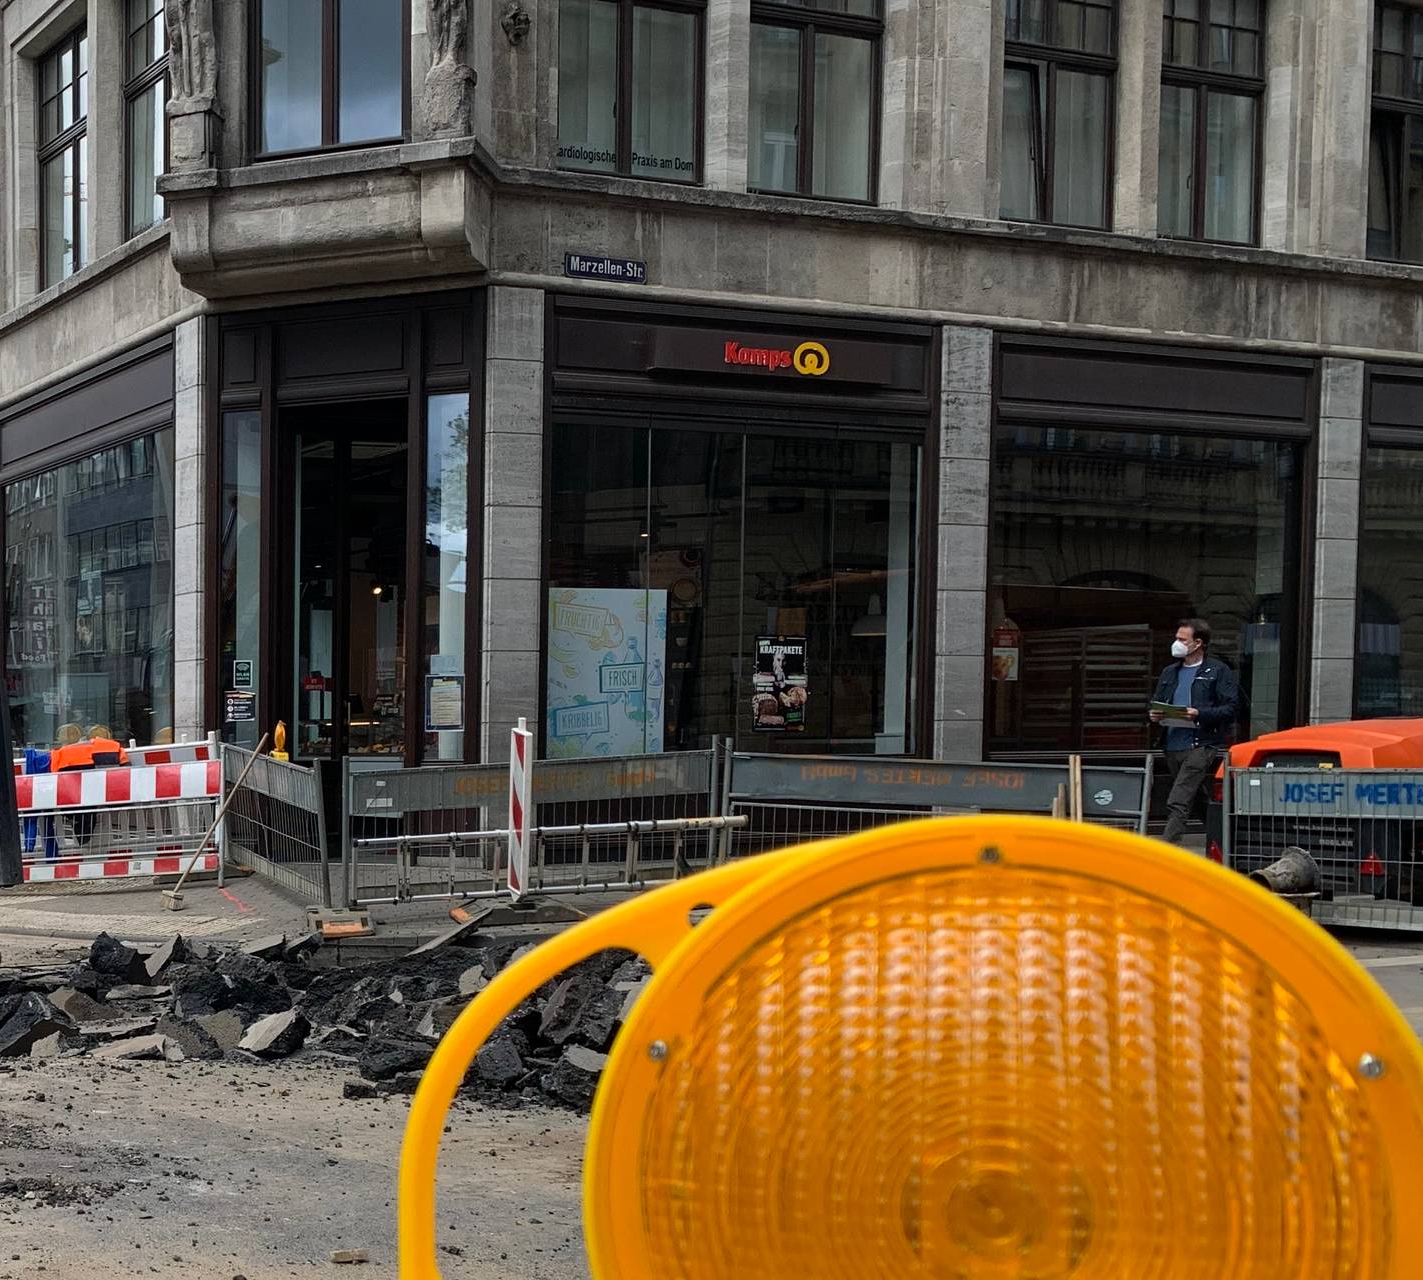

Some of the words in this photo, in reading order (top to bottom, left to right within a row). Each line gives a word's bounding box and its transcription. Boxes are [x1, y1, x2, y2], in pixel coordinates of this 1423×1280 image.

[632, 152, 657, 168] Praxis
[660, 157, 673, 169] am
[675, 157, 694, 171] Dom
[570, 255, 644, 279] Marzellen-Str.
[724, 341, 793, 371] Kamps
[759, 645, 803, 655] KRAFTPAKETE
[608, 670, 638, 687] FRISCH
[1279, 783, 1345, 804] JOSEF
